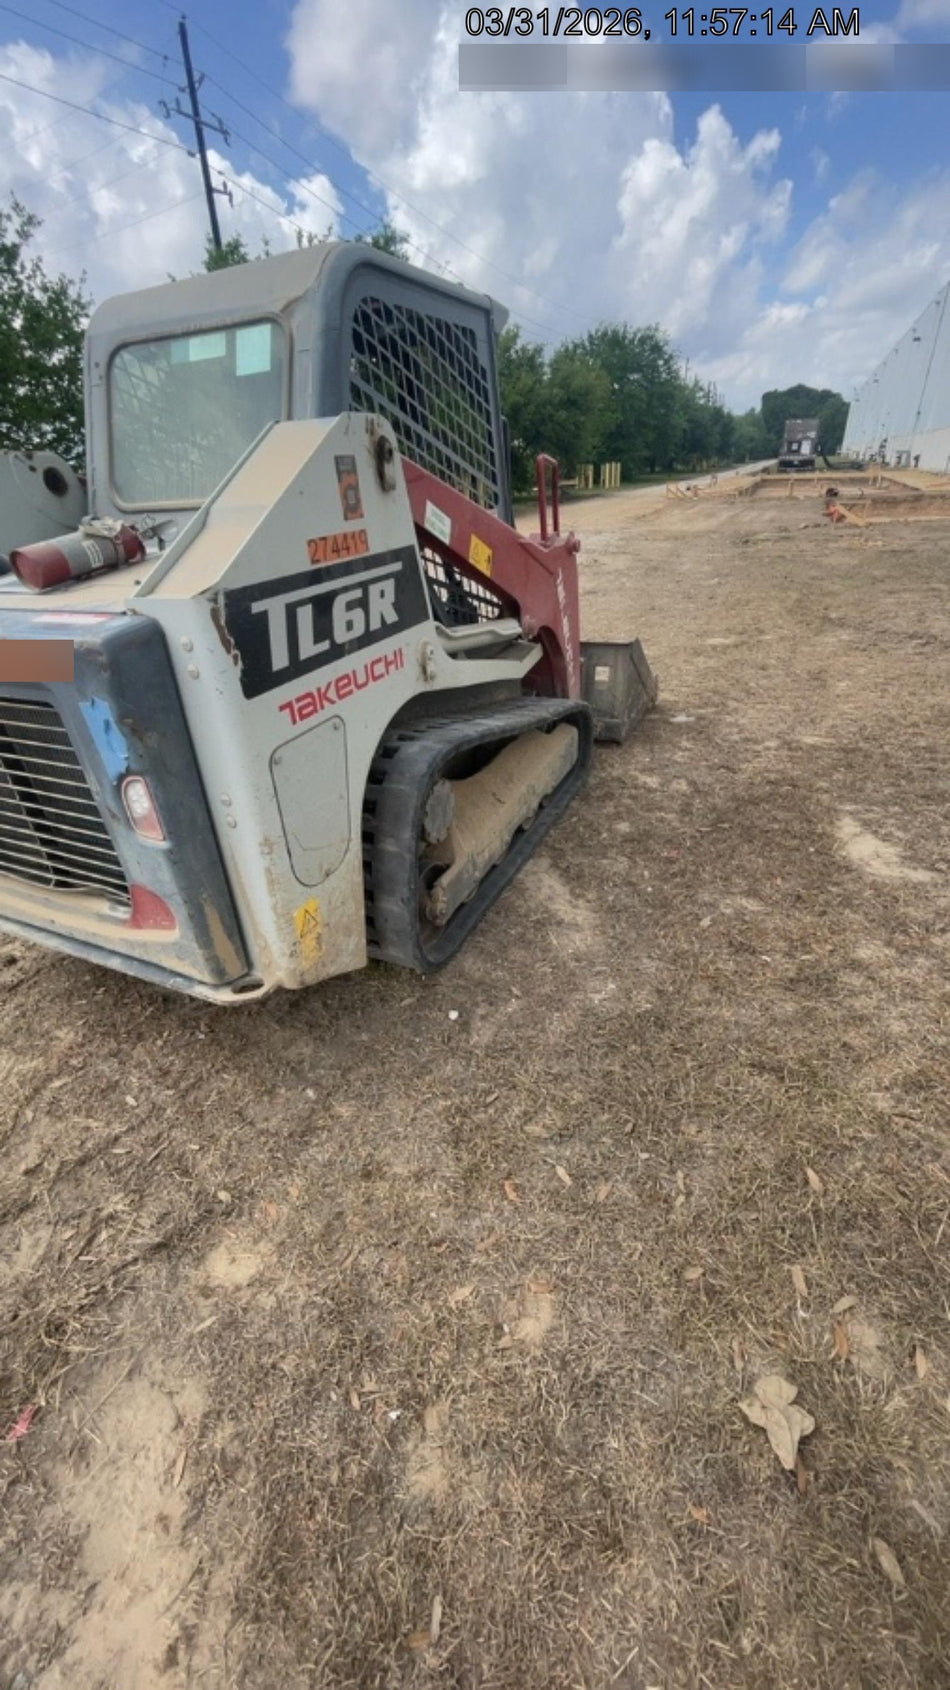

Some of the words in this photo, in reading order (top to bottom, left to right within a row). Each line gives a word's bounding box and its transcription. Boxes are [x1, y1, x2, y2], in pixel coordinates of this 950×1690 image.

[307, 529, 369, 565] 274419
[251, 561, 403, 673] TL6R
[278, 647, 405, 726] TAKEUCHI
